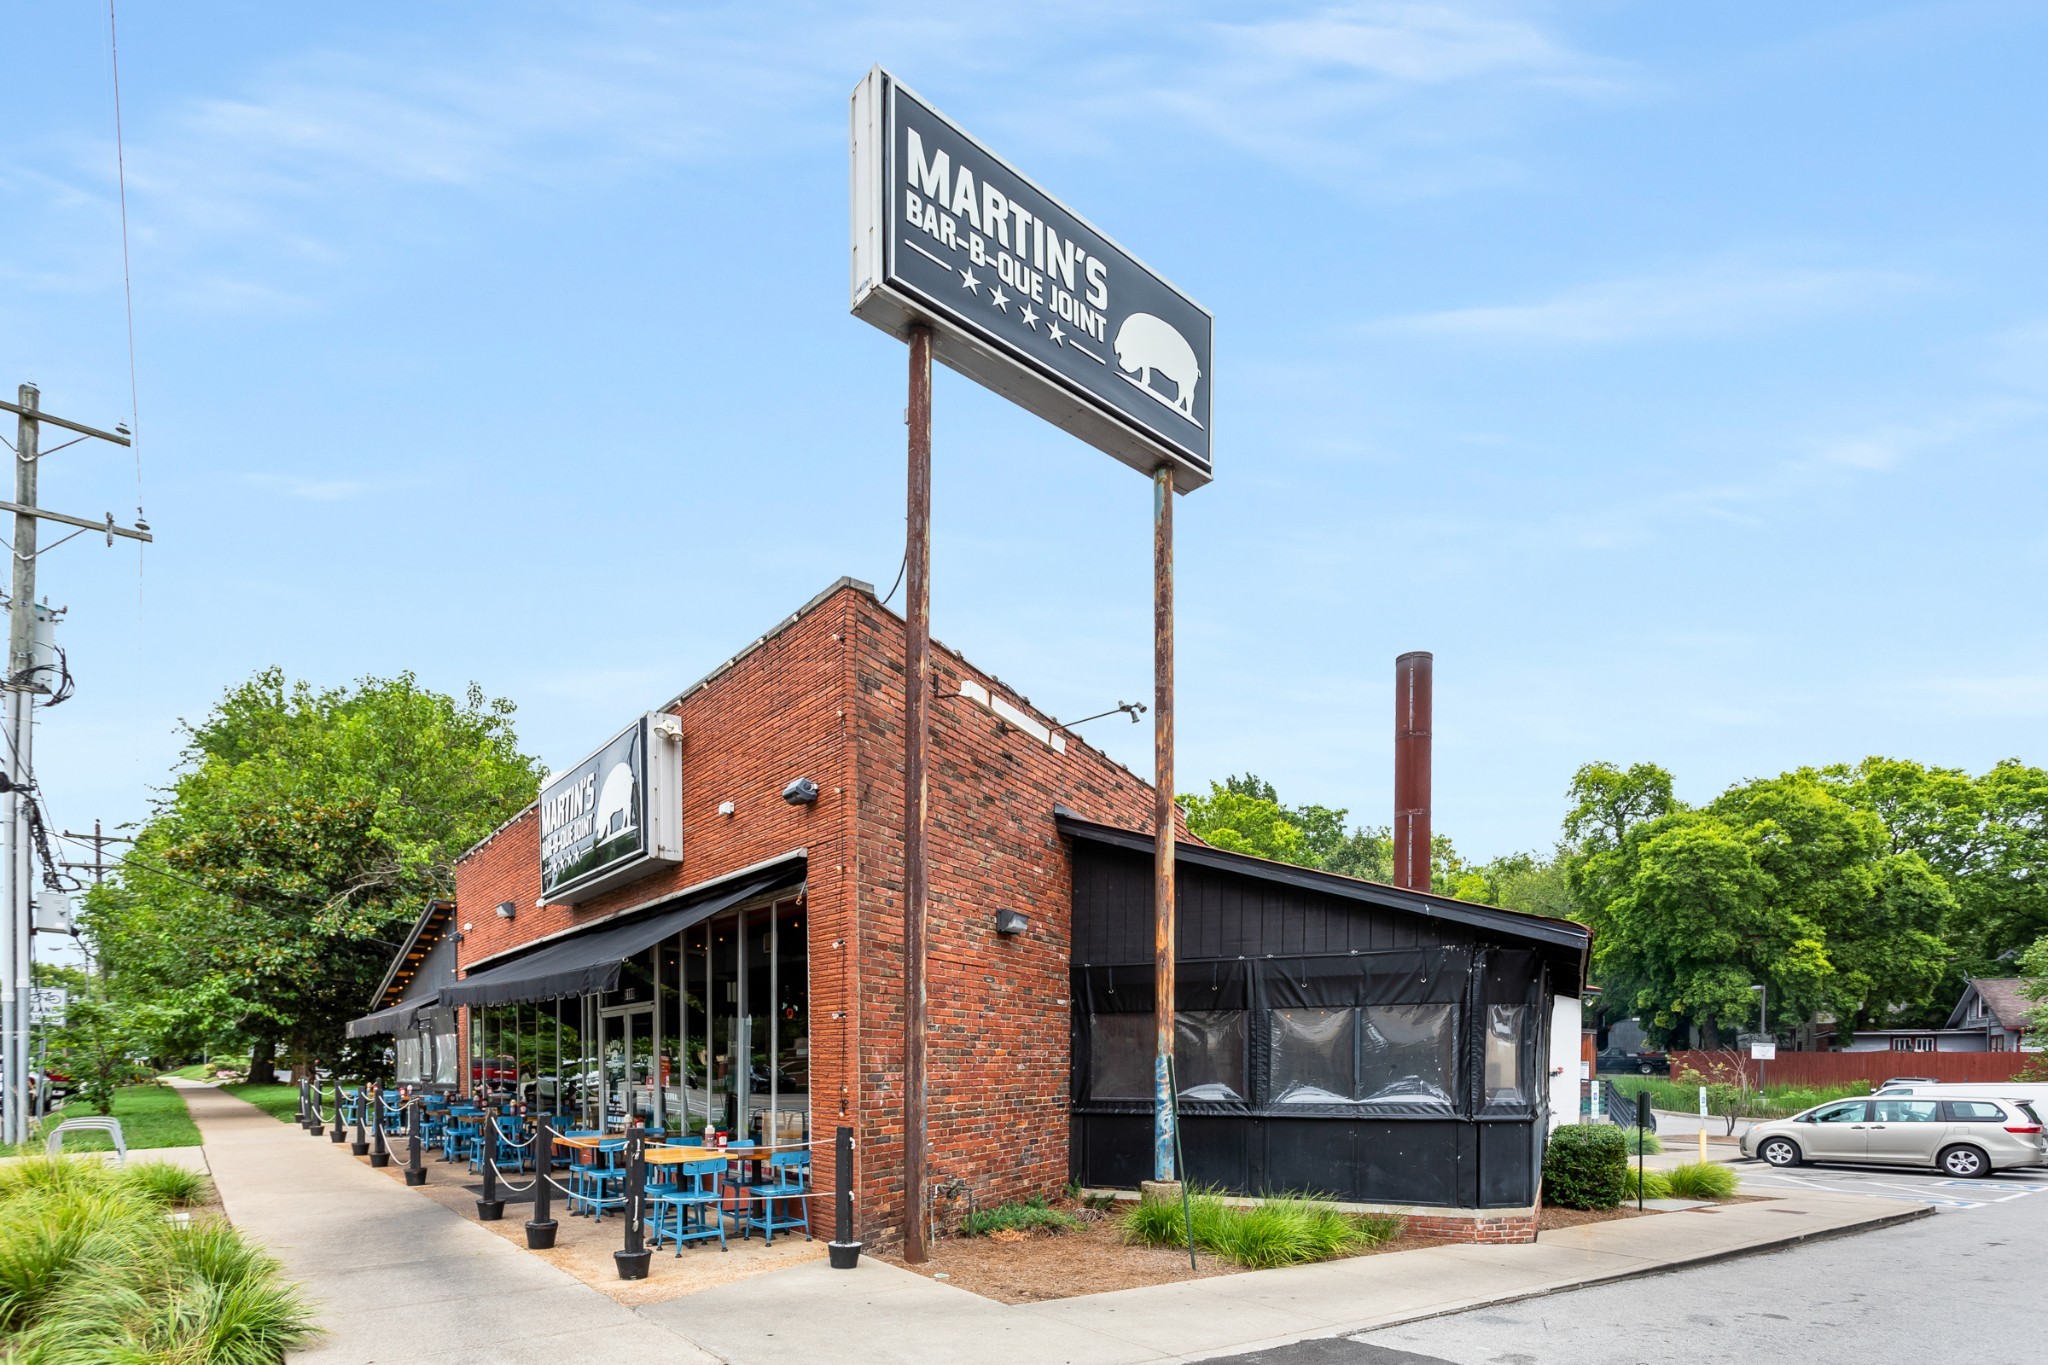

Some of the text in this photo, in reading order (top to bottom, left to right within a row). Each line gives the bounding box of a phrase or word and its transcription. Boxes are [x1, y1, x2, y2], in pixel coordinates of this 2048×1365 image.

[906, 188, 1108, 343] BAR-B-QUE JOINT
[907, 126, 1109, 311] MARTIN'S
[542, 772, 595, 839] MARTIN'S
[574, 813, 594, 843] JOINT
